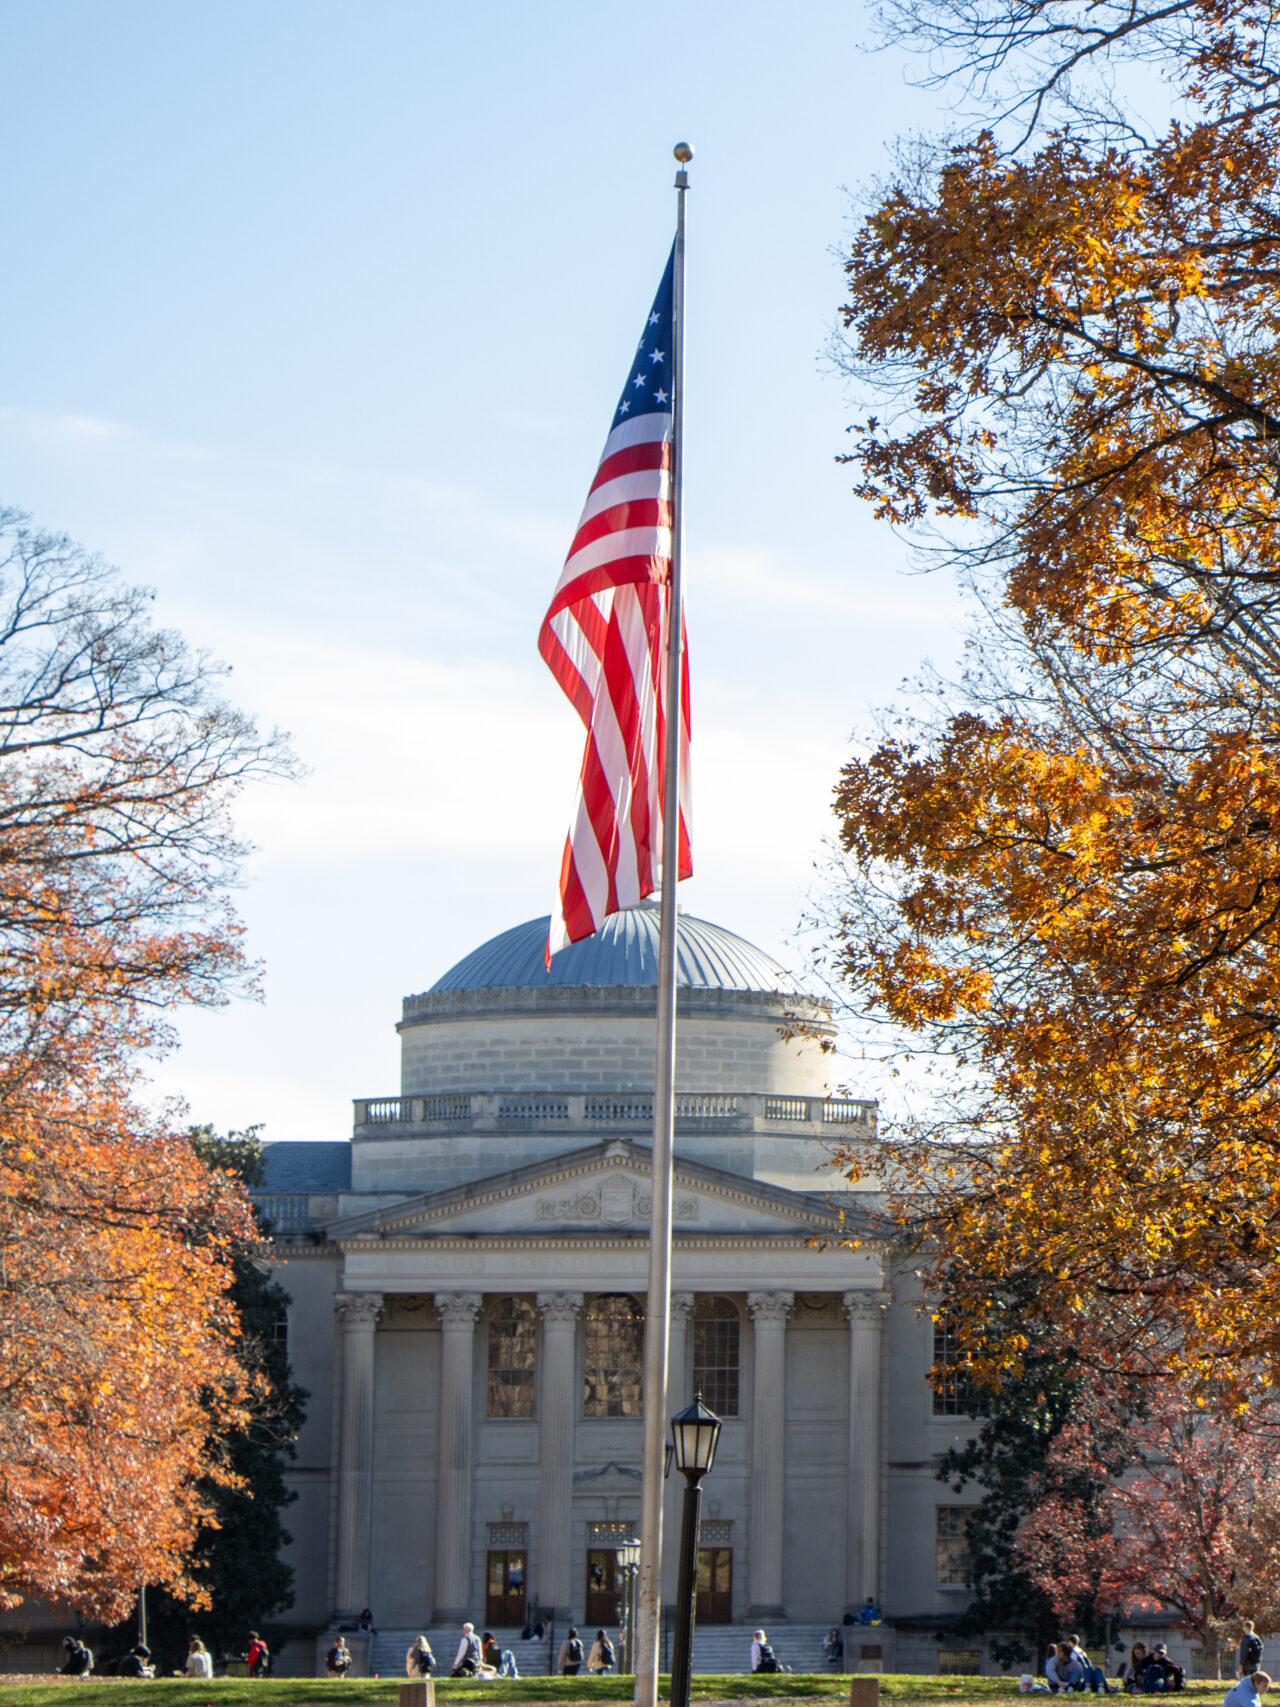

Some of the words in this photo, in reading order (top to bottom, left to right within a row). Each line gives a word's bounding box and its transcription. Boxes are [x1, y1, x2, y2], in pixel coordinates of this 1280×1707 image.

[423, 1255, 486, 1270] LOUIS
[508, 1255, 585, 1270] ROUND
[602, 1255, 689, 1270] WILN
[711, 1255, 806, 1270] LIBRARY
